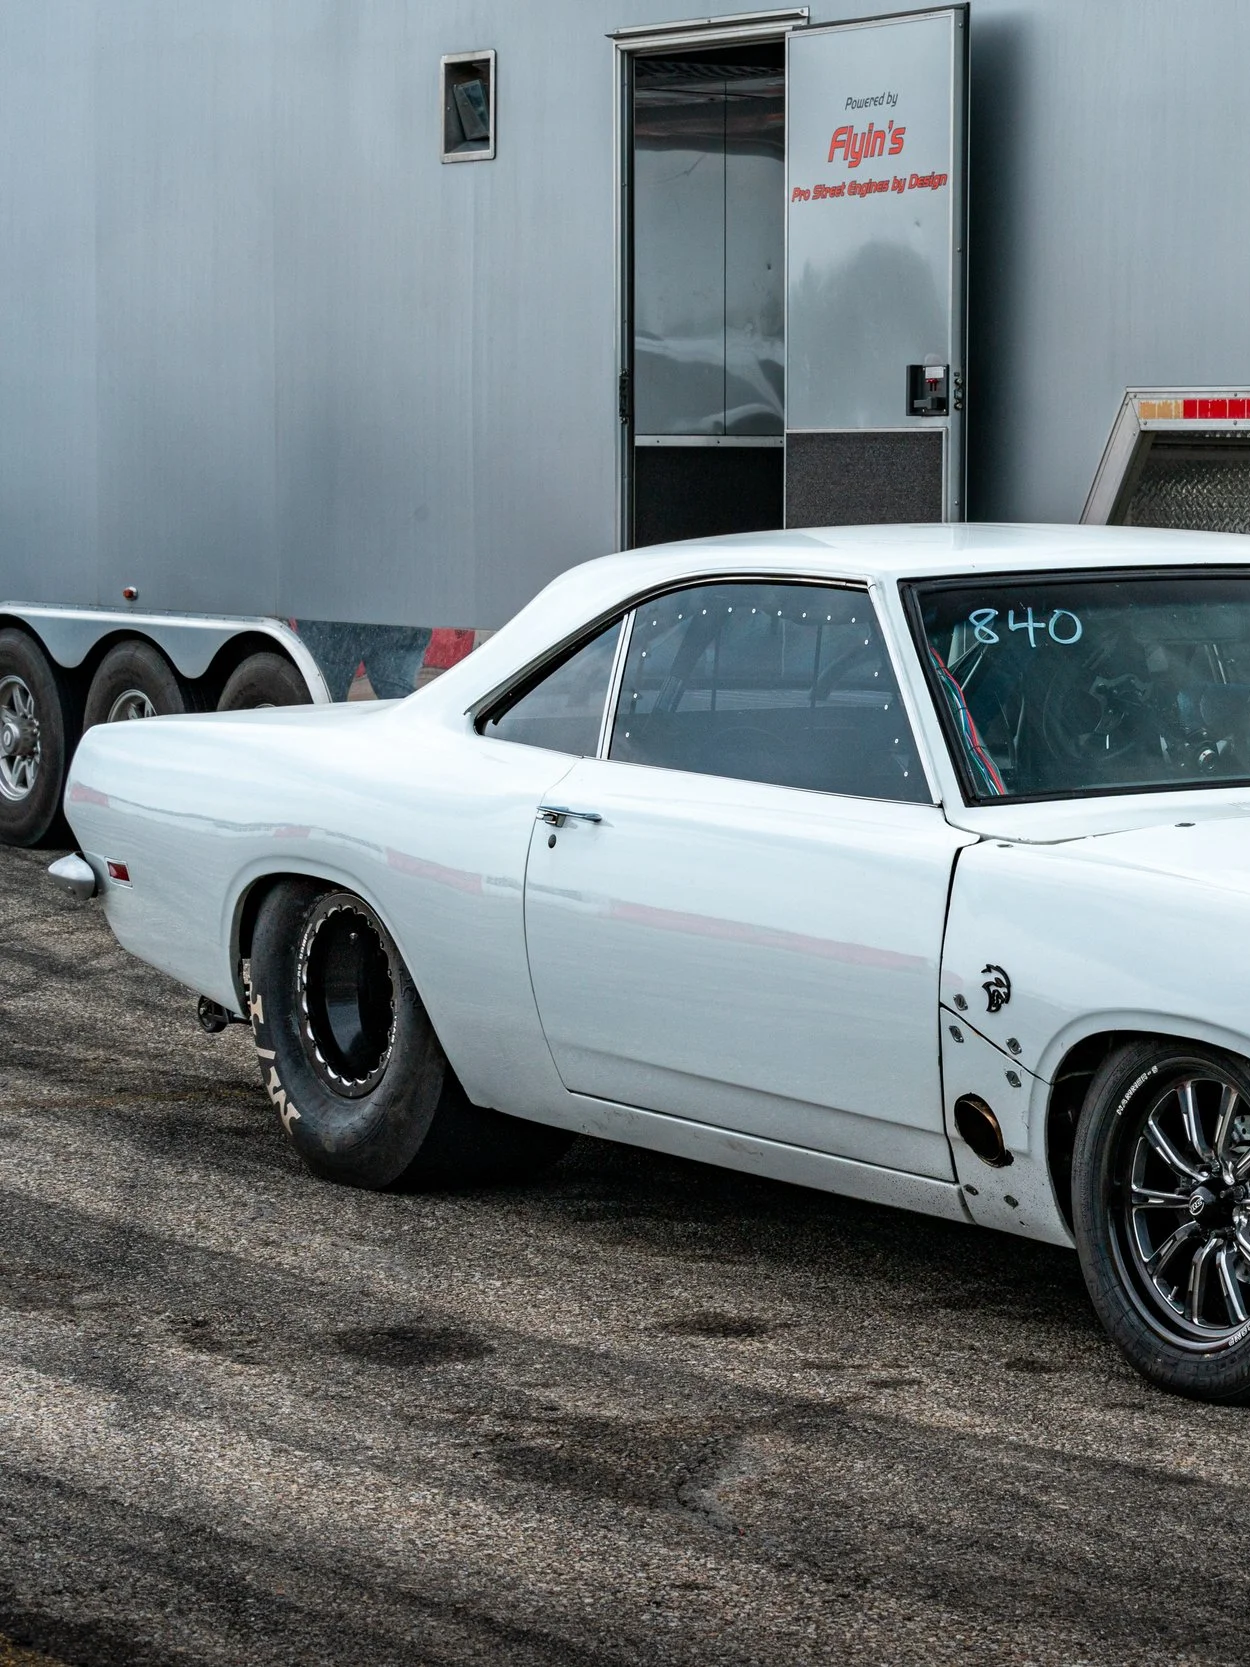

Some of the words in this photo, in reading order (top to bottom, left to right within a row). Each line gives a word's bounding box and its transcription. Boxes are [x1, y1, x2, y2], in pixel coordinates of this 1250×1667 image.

[845, 93, 885, 111] Powered
[886, 92, 899, 108] by
[827, 120, 906, 168] Flyin's
[791, 187, 811, 203] Pro
[812, 182, 846, 200] Street
[847, 179, 890, 198] Engines
[891, 176, 907, 195] by
[907, 171, 949, 190] Design
[968, 607, 1083, 648] 840
